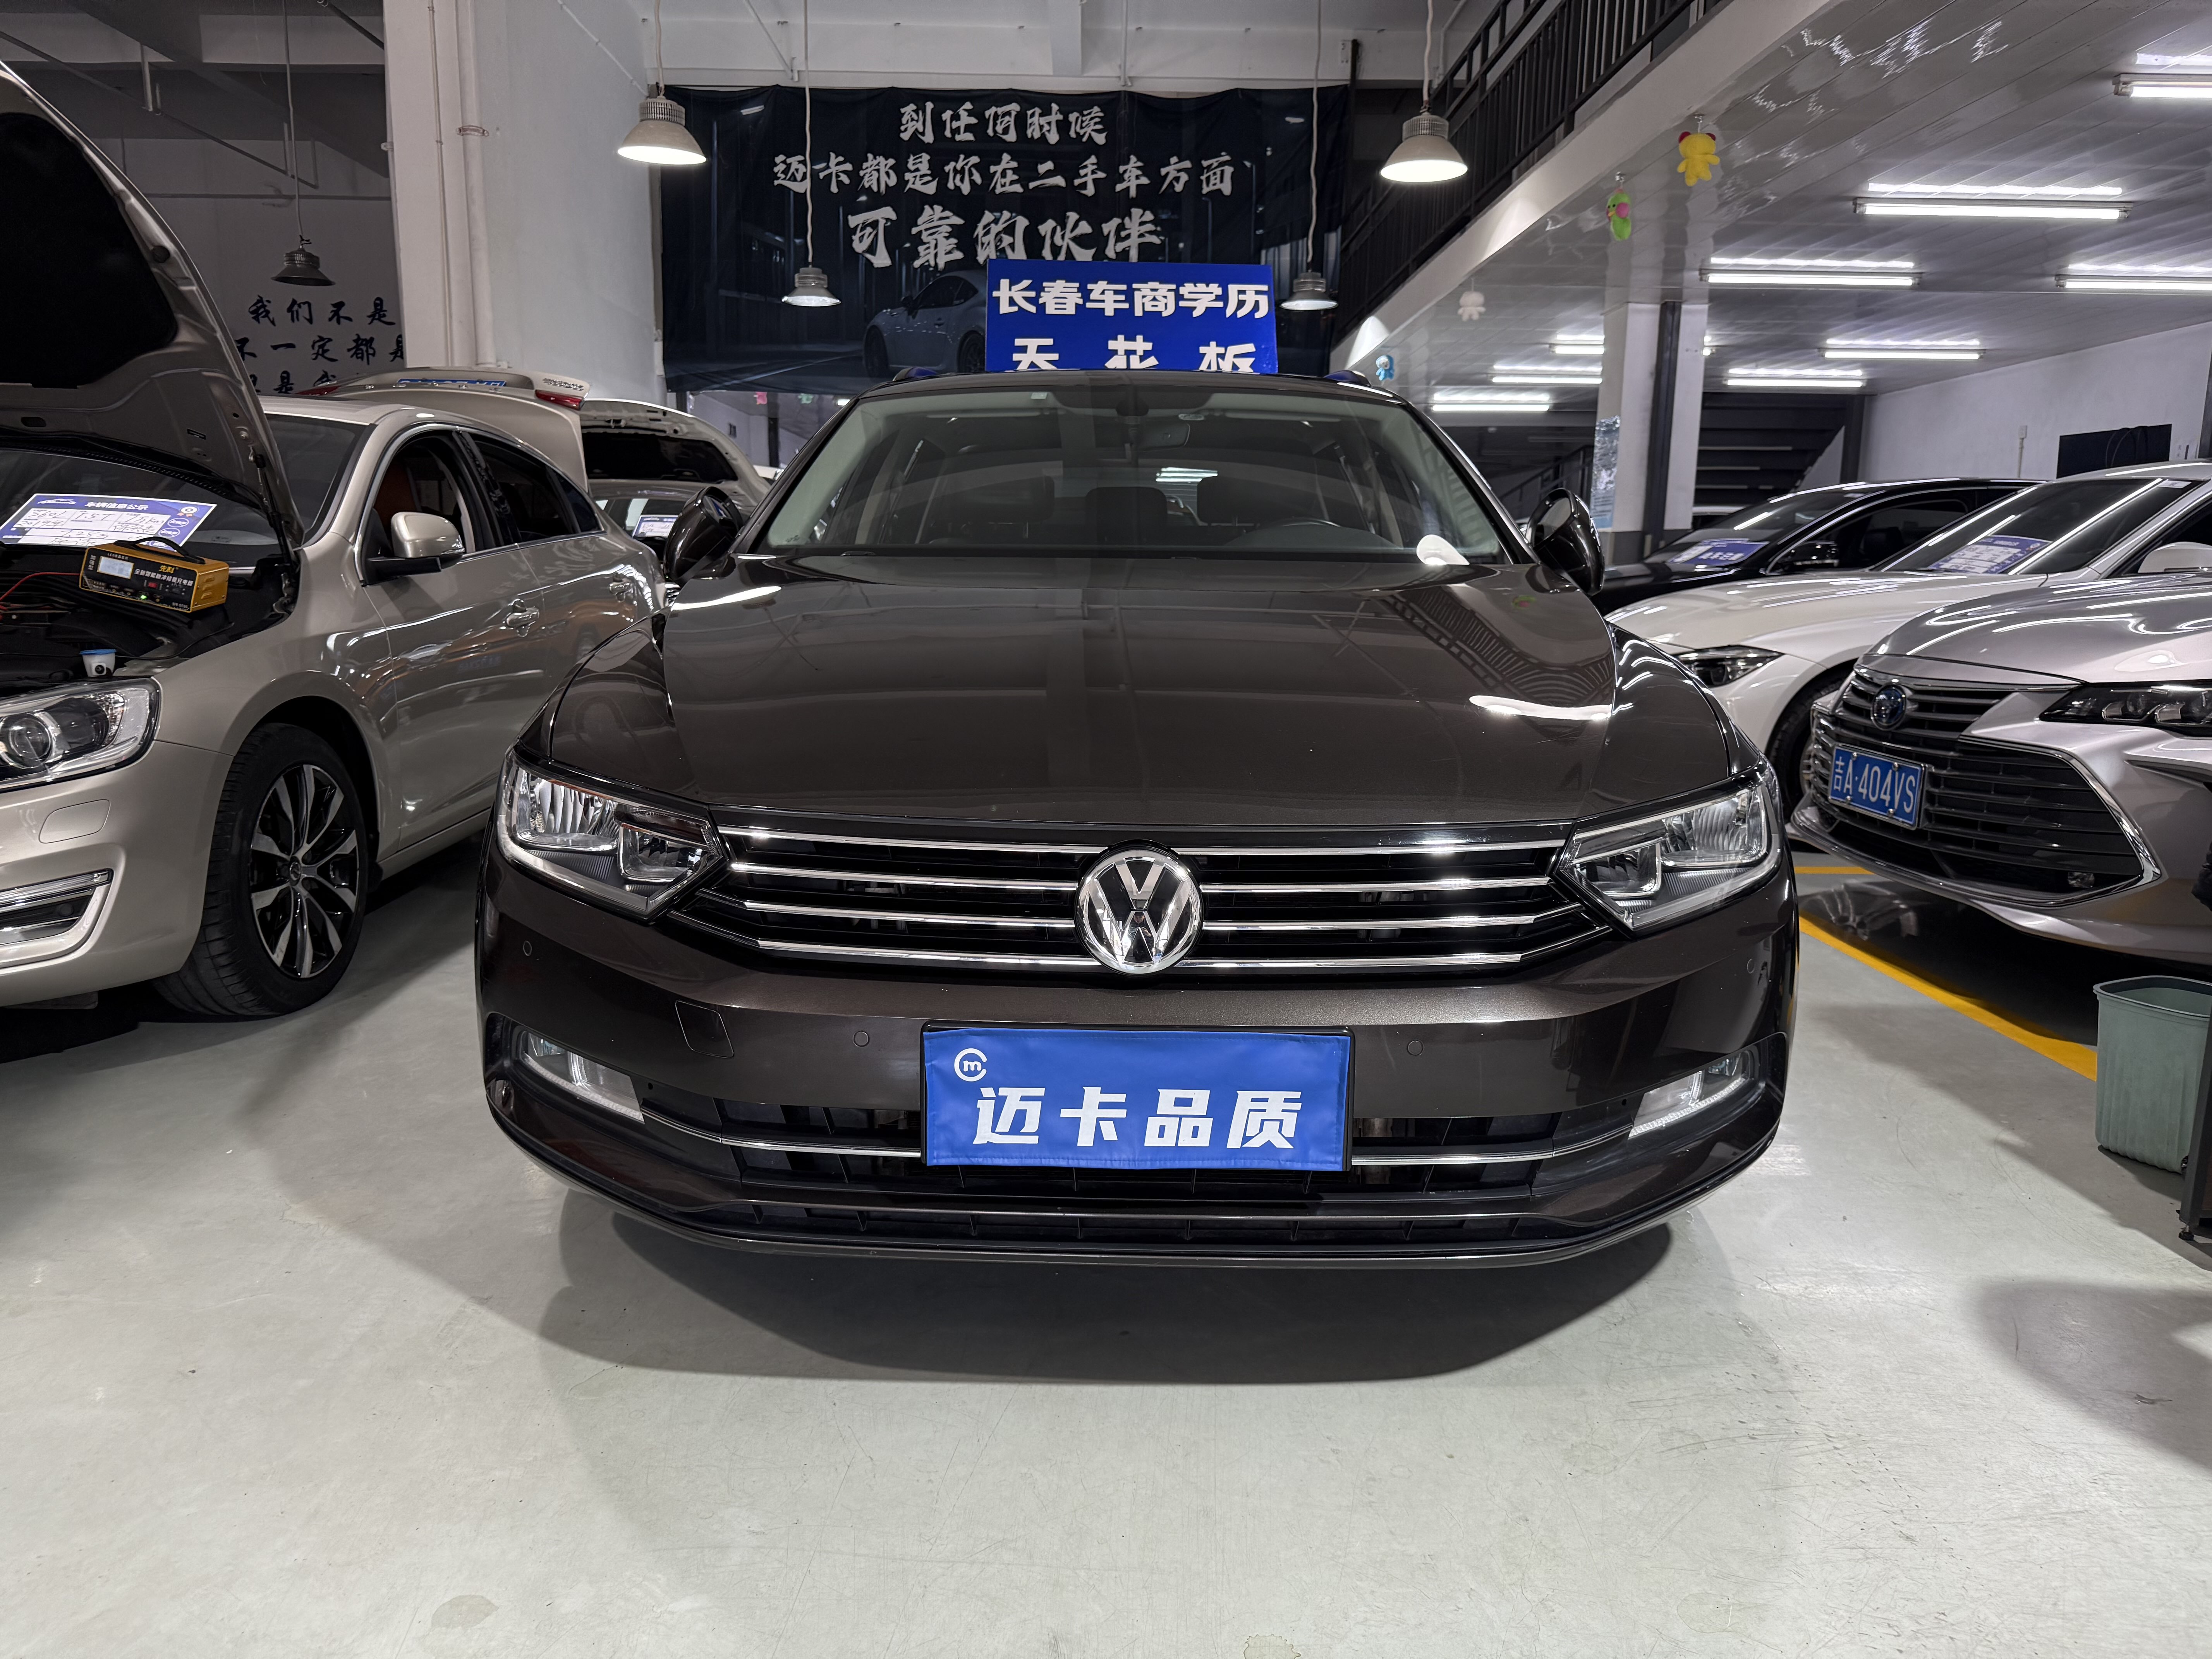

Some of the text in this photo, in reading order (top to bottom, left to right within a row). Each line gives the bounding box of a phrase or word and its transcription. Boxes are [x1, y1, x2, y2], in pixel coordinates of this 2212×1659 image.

[899, 102, 1108, 145] 到任何时候
[773, 152, 1234, 199] 迈卡都是你在二手车方面
[848, 205, 1162, 270] 可靠的伙伴
[248, 295, 396, 326] 我们不是
[992, 278, 1269, 319] 长春车商学历
[972, 1087, 1302, 1149] 迈卡品质
